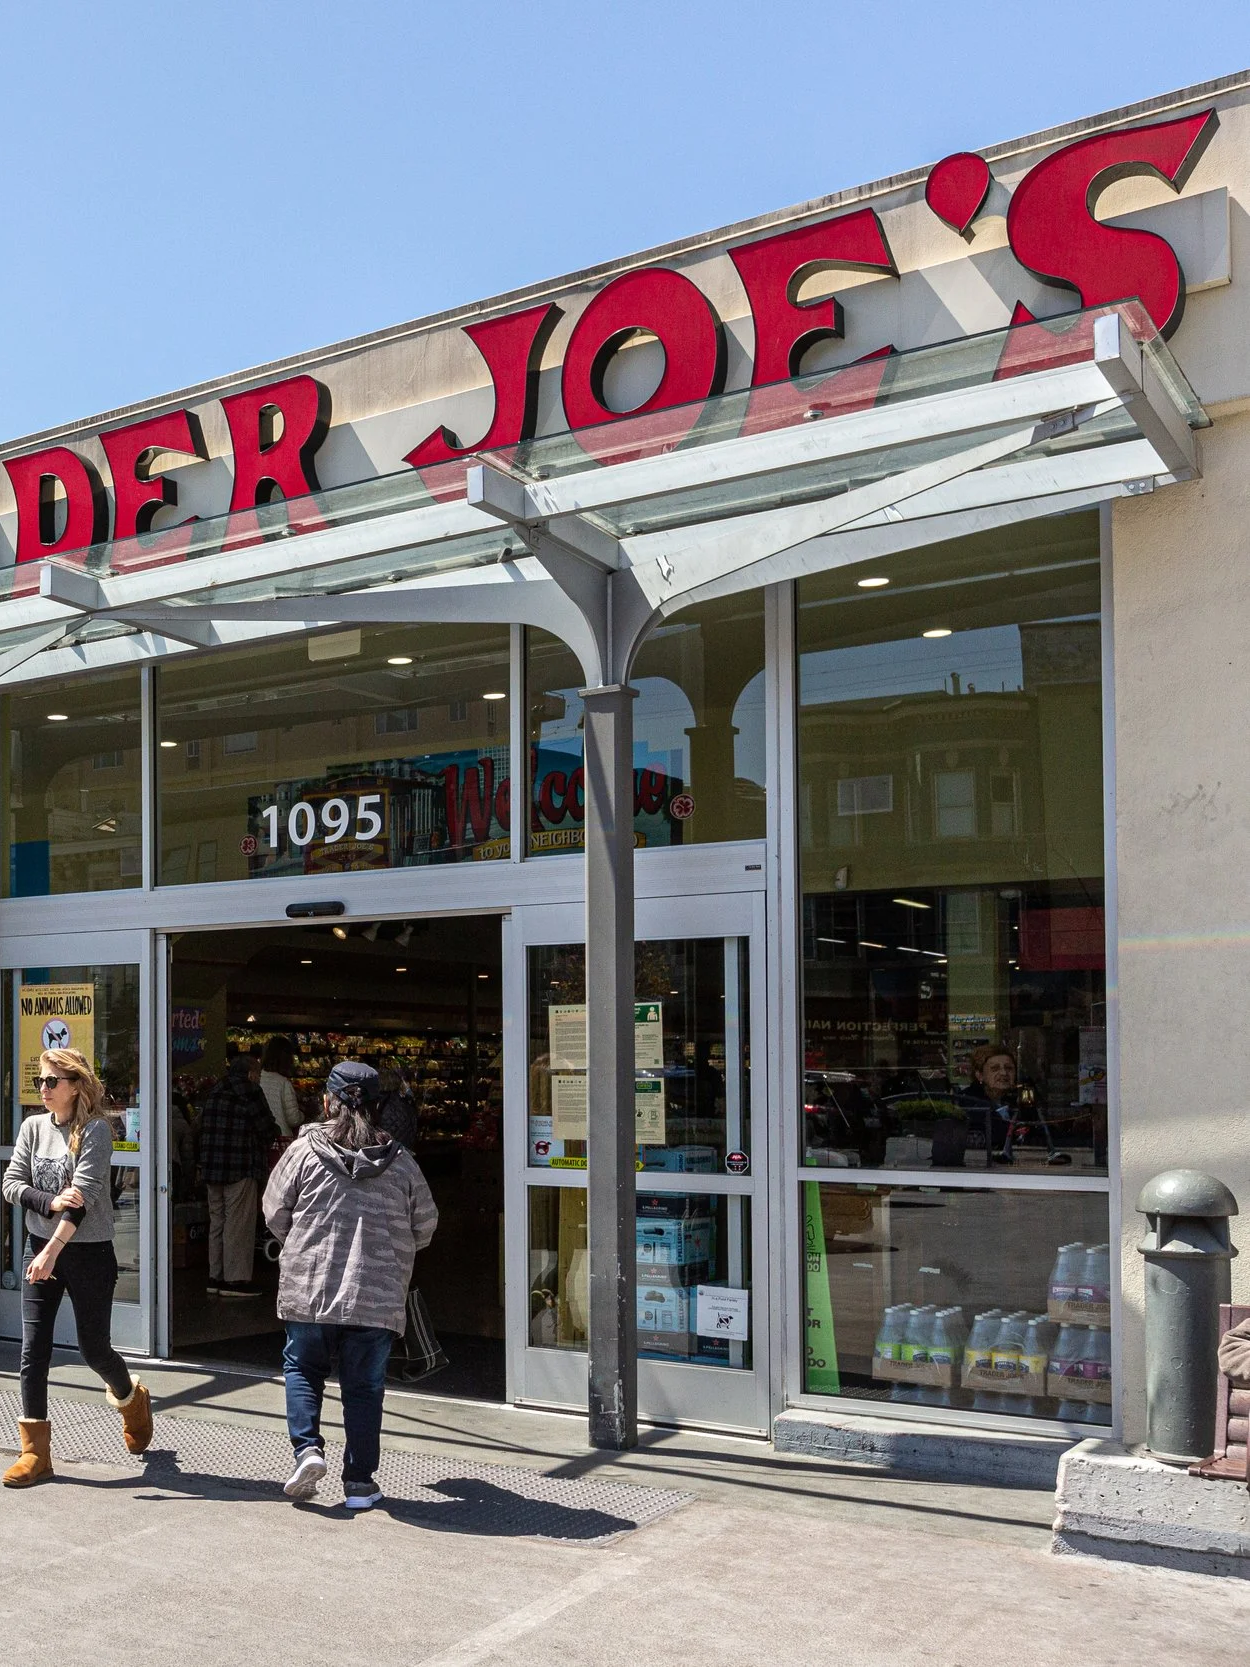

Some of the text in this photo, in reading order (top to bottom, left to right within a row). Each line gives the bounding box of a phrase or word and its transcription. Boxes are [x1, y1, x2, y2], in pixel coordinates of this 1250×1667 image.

[403, 108, 1218, 484] JOE'S
[263, 795, 382, 848] 1095
[440, 746, 667, 843] Welcoe
[21, 995, 92, 1016] NO ANIMALS ALLOWED
